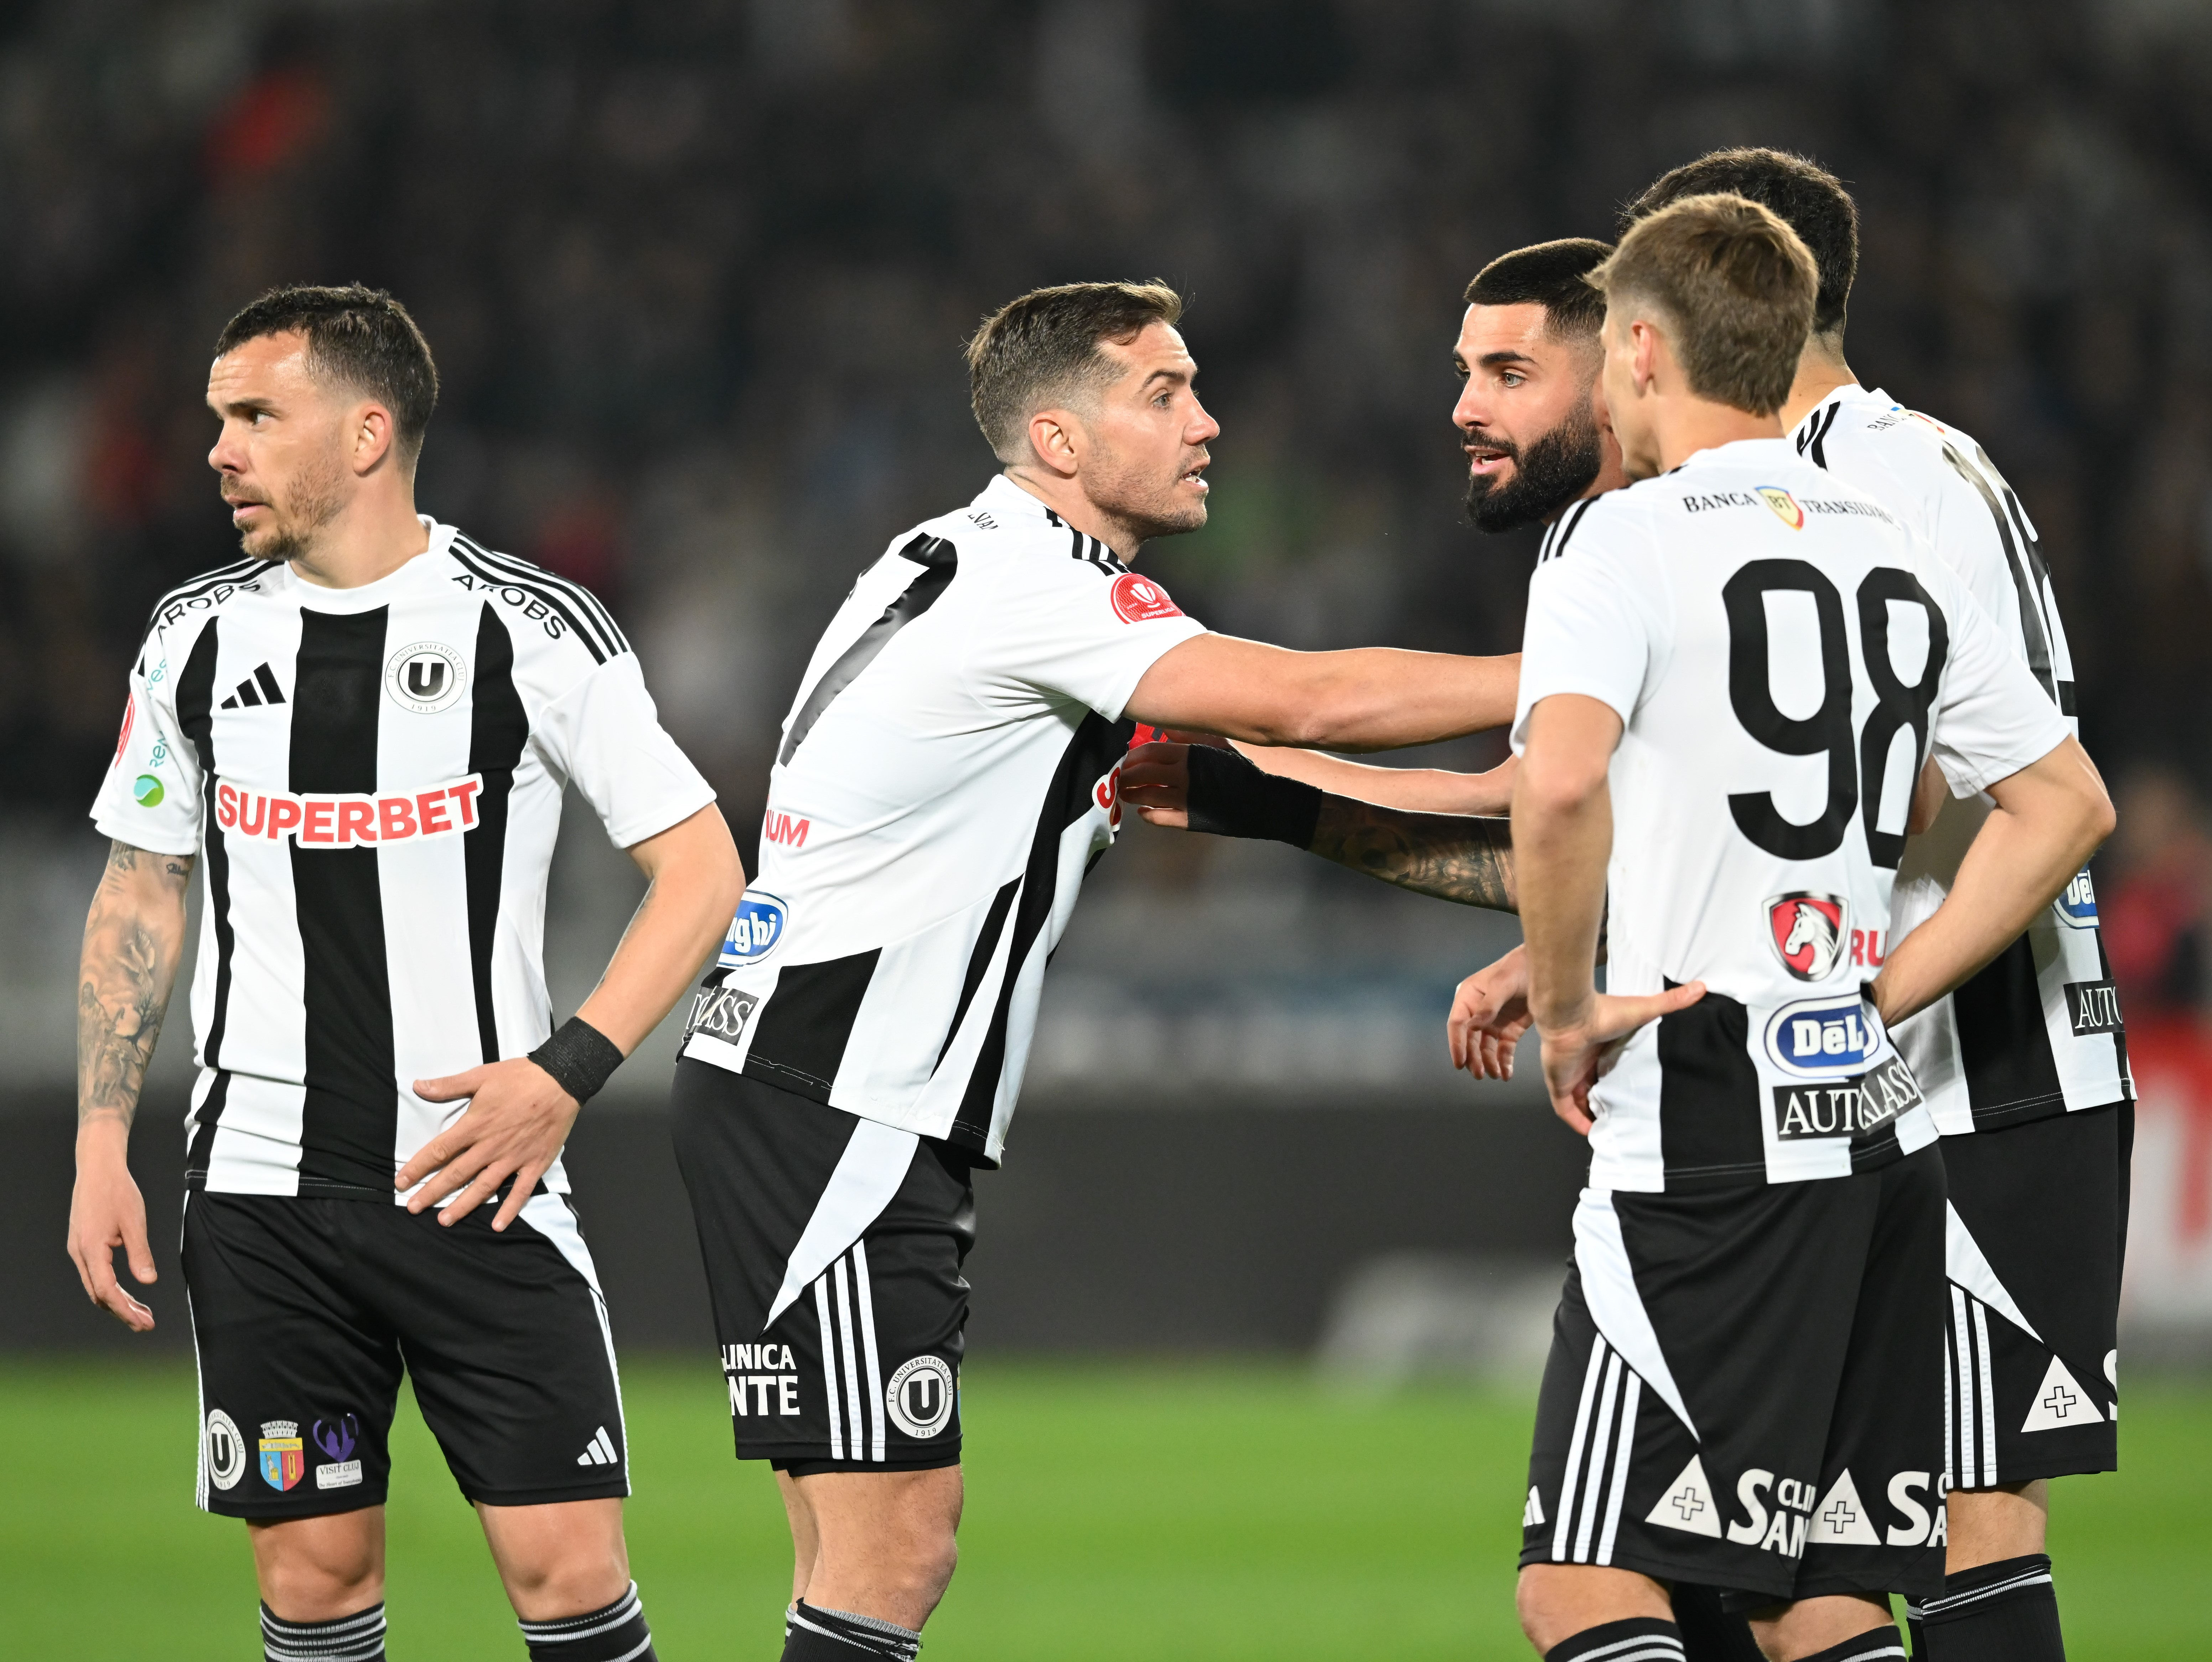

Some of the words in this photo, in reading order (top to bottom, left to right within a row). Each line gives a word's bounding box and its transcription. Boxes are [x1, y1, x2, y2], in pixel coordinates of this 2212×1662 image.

[1682, 493, 1758, 513] BANCA
[1768, 495, 1791, 510] BT
[1141, 607, 1175, 618] SUPERLIGA
[395, 644, 457, 662] UNIVERSITATEA
[456, 662, 465, 681] CLUJ
[408, 662, 445, 697] U
[1722, 558, 1949, 870] 98
[218, 780, 478, 842] SUPERBET
[888, 1387, 896, 1402] F.C.
[893, 1357, 947, 1383] UNIVERSITATEA
[908, 1378, 940, 1420] U
[234, 1433, 244, 1454] CLUJ
[915, 1427, 937, 1436] 1919
[211, 1433, 230, 1472] U
[320, 1464, 342, 1475] VISIT
[343, 1462, 359, 1472] CLUJ
[217, 1479, 230, 1488] 1919
